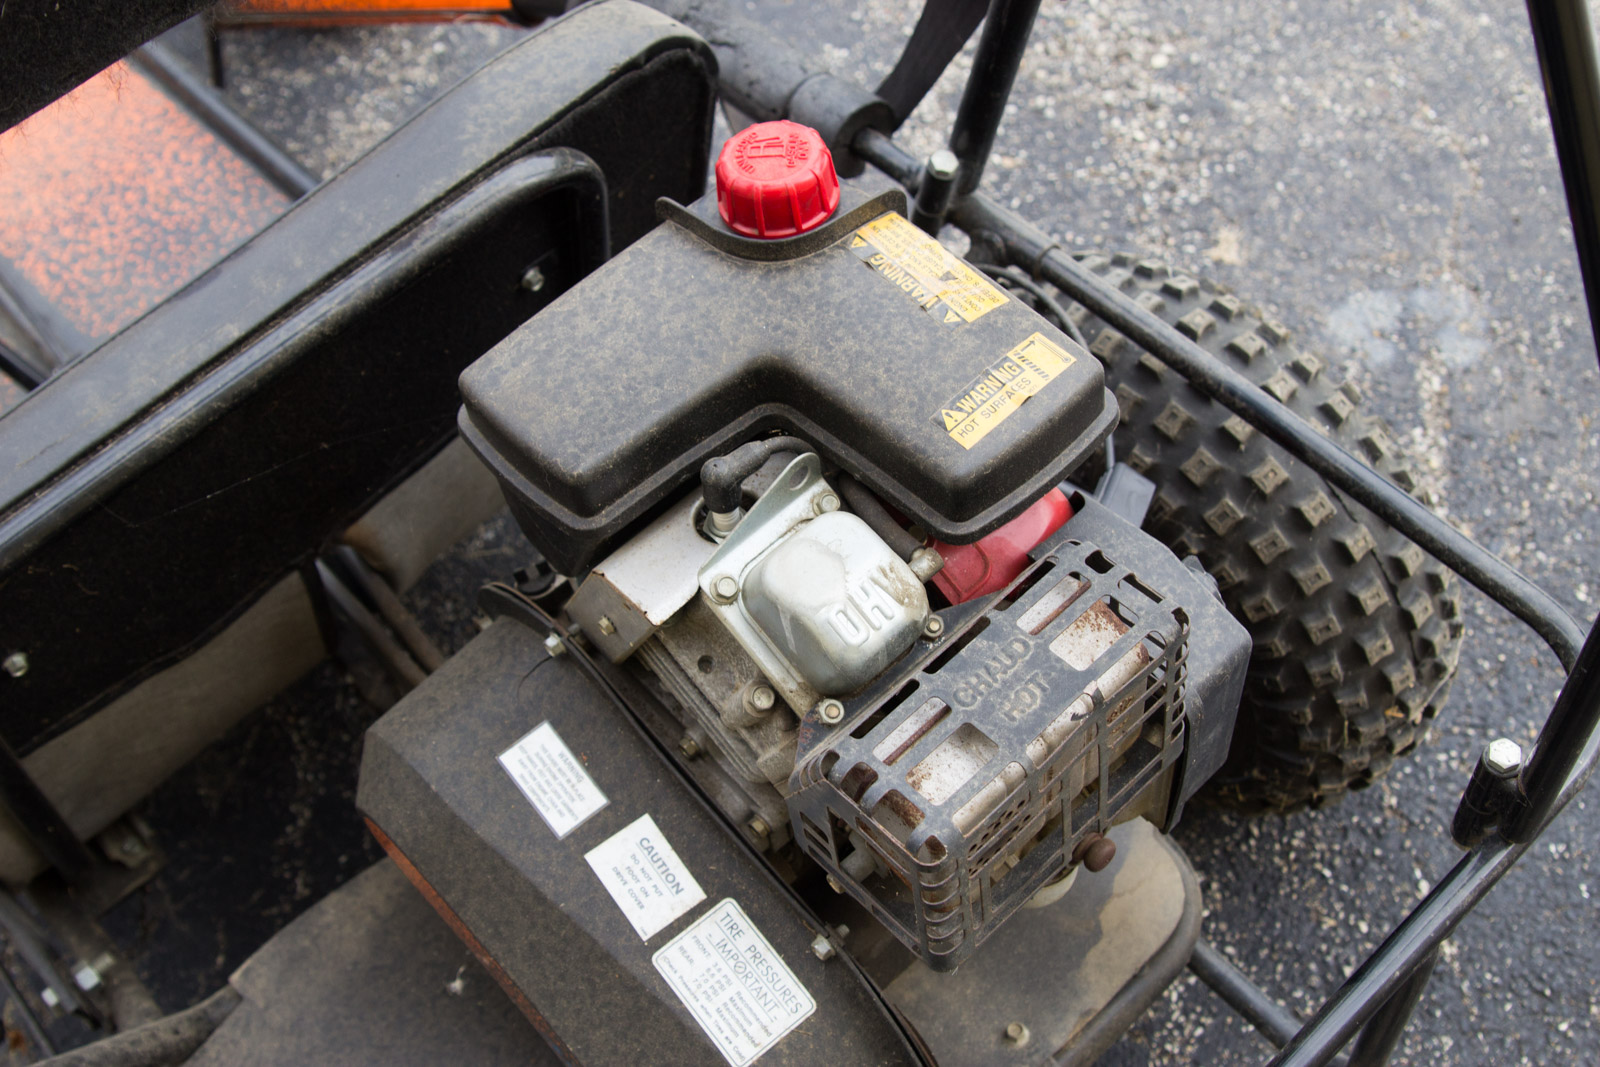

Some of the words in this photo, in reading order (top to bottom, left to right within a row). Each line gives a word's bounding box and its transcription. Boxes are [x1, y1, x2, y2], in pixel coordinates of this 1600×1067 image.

[868, 253, 940, 309] WARNING
[957, 418, 979, 437] HOT
[980, 376, 1031, 418] SURFACES
[952, 636, 1033, 708] CHAUD
[1000, 671, 1050, 722] HOT
[556, 750, 584, 784] WARNING
[610, 866, 628, 886] DRIVE
[626, 887, 645, 910] COVER
[624, 865, 641, 884] FOOT
[638, 885, 650, 898] ON
[629, 853, 640, 865] DO
[638, 866, 652, 883] NOT
[650, 883, 663, 898] PUT
[637, 836, 684, 895] CAUTION
[715, 938, 780, 1015] IMPORTANT
[718, 911, 745, 941] TIRE
[743, 944, 803, 1015] PRESSURES
[701, 989, 713, 1003] PSI
[714, 1006, 740, 1038] Maximum
[708, 984, 720, 997] PSI
[721, 1001, 759, 1048] Recommended
[714, 979, 726, 992] PSI
[727, 996, 753, 1027] Maximum
[721, 973, 733, 987] PSI
[734, 990, 772, 1037] Recommended
[724, 1035, 732, 1045] are
